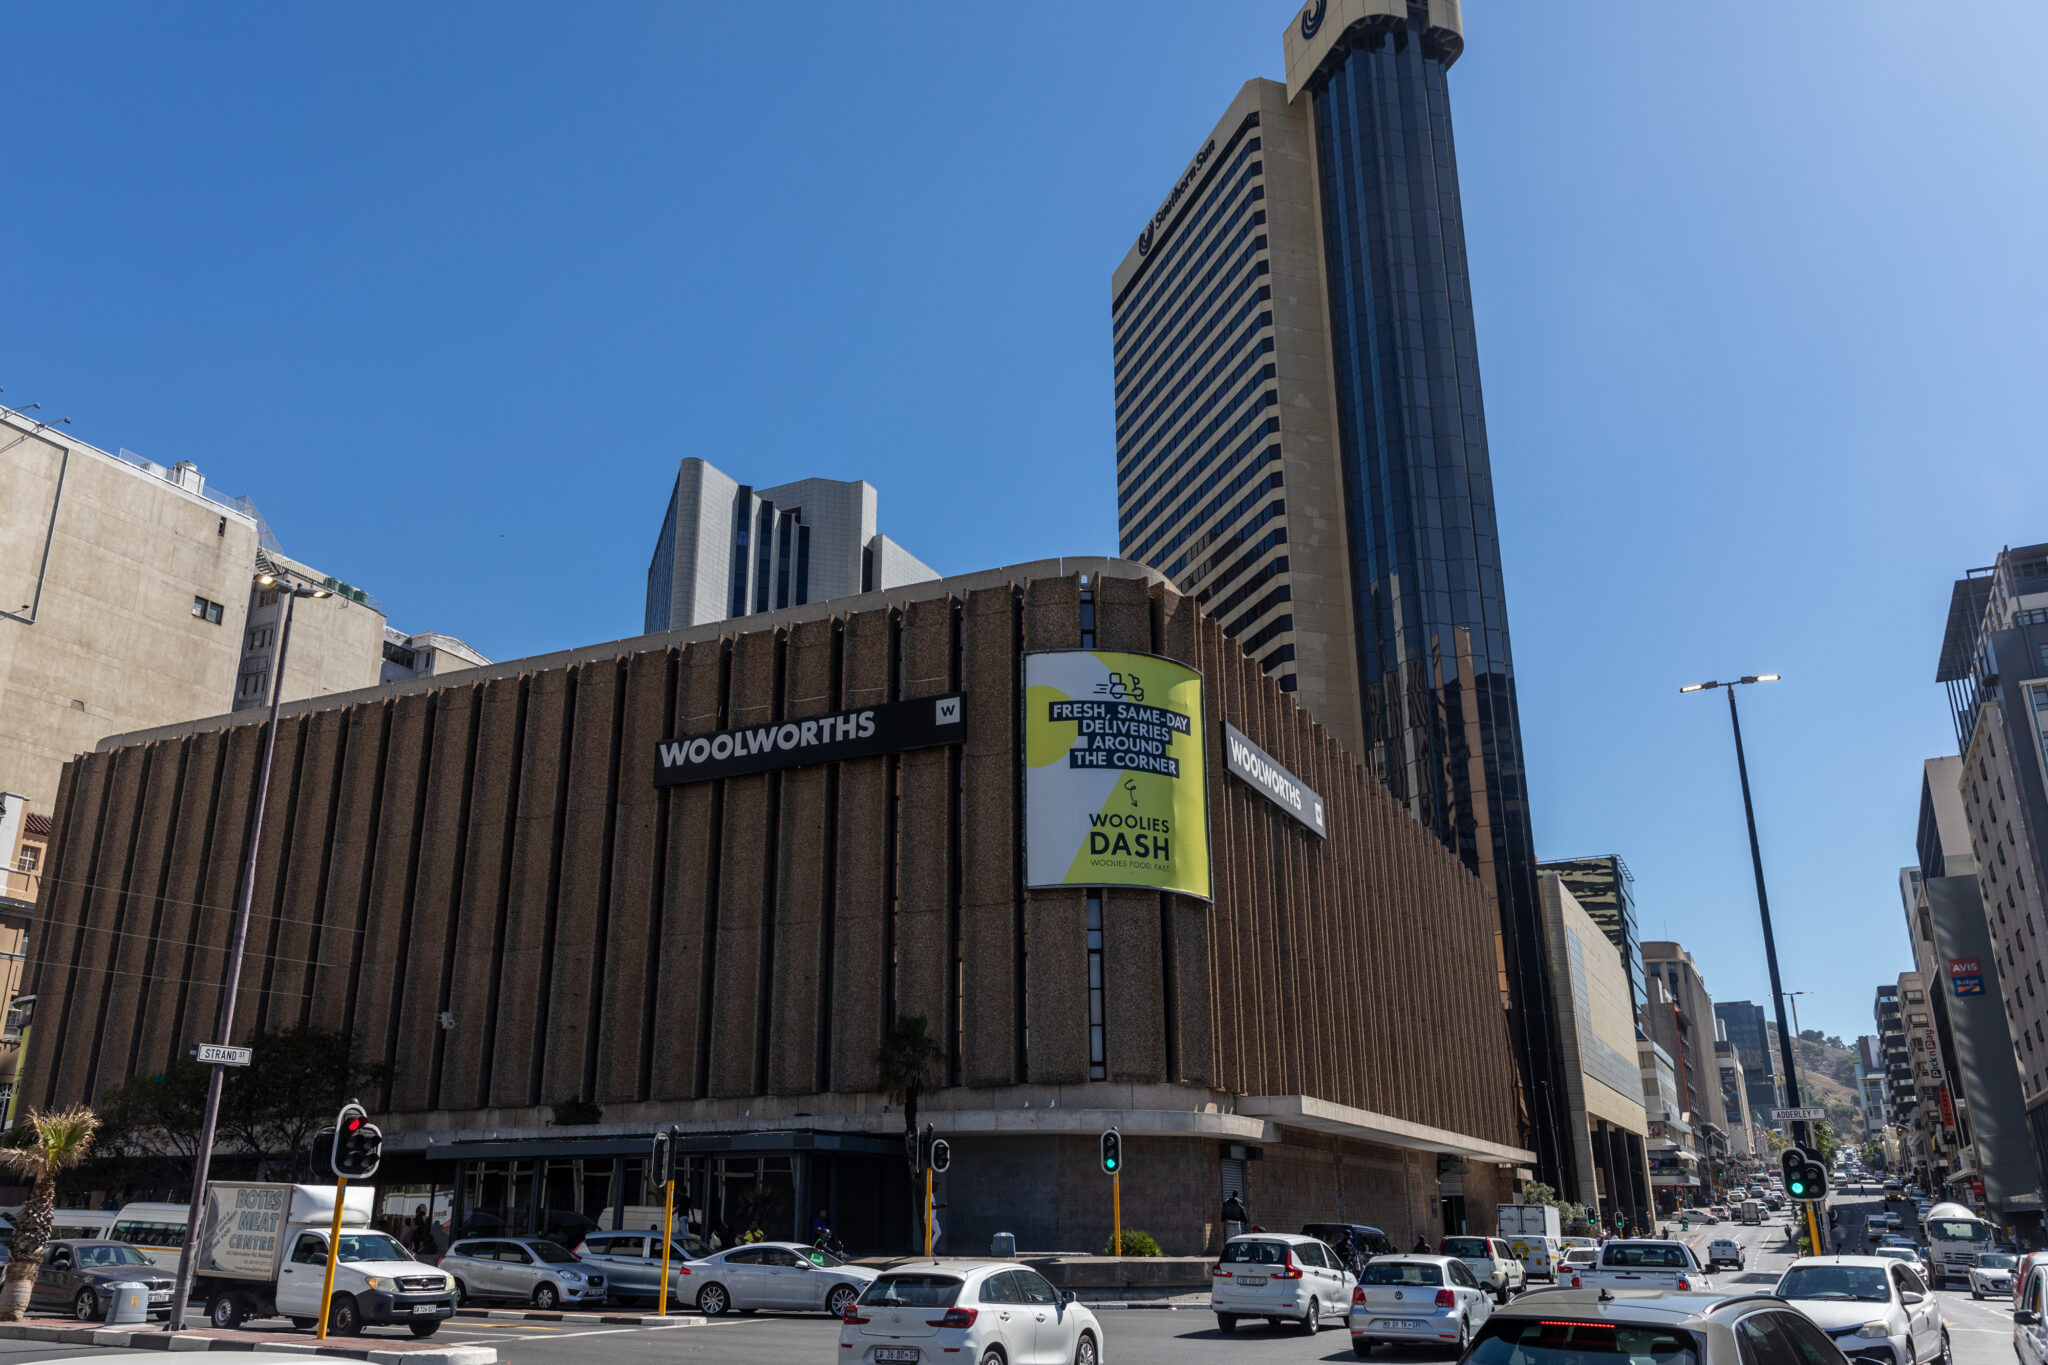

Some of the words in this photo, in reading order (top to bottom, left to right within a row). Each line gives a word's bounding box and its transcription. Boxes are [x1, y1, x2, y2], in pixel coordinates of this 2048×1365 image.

[1155, 166, 1196, 230] Southern
[1196, 139, 1216, 172] Sun
[940, 704, 955, 717] W
[1053, 703, 1111, 720] FRESH,
[1117, 706, 1188, 731] SAME-DAY
[660, 710, 875, 768] WOOLWORTHS
[1082, 719, 1170, 742] DELIVERIES
[1092, 736, 1163, 755] AROUND
[1074, 751, 1107, 766] THE
[1113, 754, 1177, 775] CORNER
[1230, 735, 1302, 810] WOOLWORTHS
[1088, 813, 1170, 834] WOOLIES
[1090, 831, 1170, 861] DASH
[1090, 859, 1127, 867] WOOLIES
[1129, 860, 1153, 870] FOOD.
[1952, 962, 1978, 973] AVIS
[1925, 1029, 1937, 1050] Pay
[204, 1048, 237, 1061] STRAND
[1930, 1057, 1942, 1078] Pick
[1776, 1110, 1811, 1119] ADDERLEY
[236, 1189, 282, 1211] BOTES
[237, 1211, 280, 1232] MEAT
[228, 1233, 276, 1251] CENTRE
[909, 1350, 918, 1360] GP
